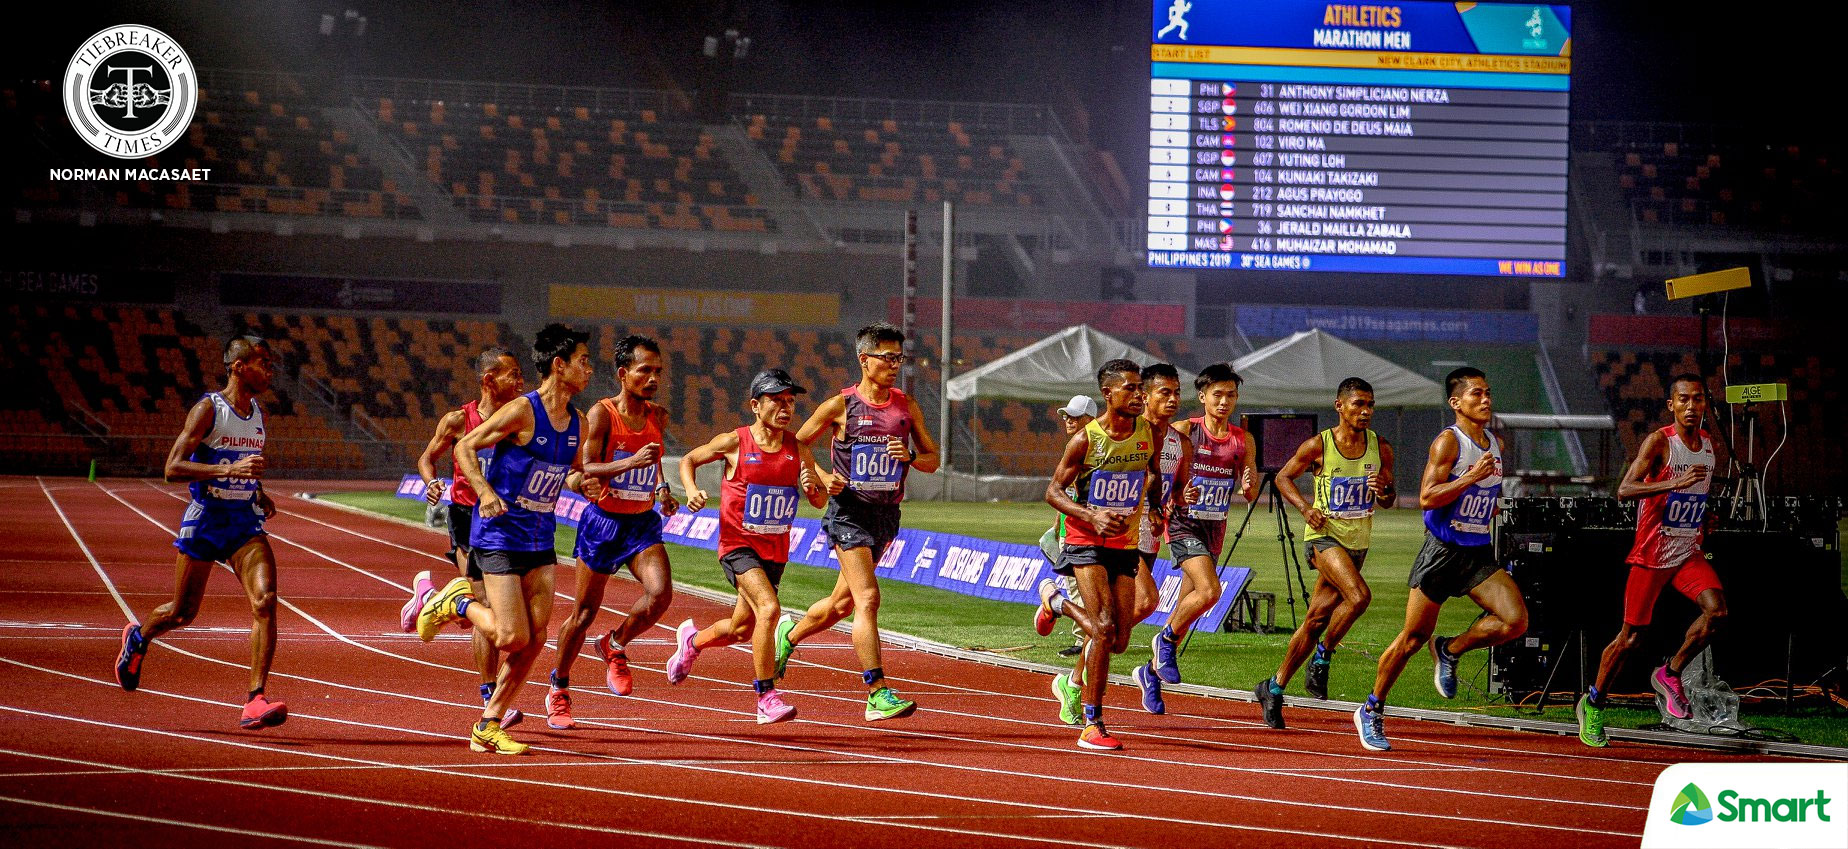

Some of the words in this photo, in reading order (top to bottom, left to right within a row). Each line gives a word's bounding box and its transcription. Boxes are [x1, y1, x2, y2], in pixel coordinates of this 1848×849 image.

[1323, 4, 1402, 28] ATHLETICS
[1313, 28, 1382, 49] MARATHON
[1383, 31, 1411, 50] MEN
[1152, 48, 1186, 59] START
[1188, 49, 1211, 60] LIST
[1378, 56, 1400, 65] NEW
[1403, 57, 1436, 66] CLARK
[1466, 58, 1520, 68] ATHLETICS
[1524, 59, 1567, 69] STADIUM
[1200, 83, 1220, 97] PHI
[1260, 84, 1275, 98] 31
[1279, 85, 1335, 100] ANTHONY
[1336, 87, 1410, 101] SIMPLICIANO
[1410, 89, 1450, 103] NERZA
[1254, 101, 1275, 115] 606
[1279, 102, 1301, 117] WEI
[1302, 103, 1339, 118] XIANG
[1339, 104, 1388, 119] GORDON
[1389, 105, 1411, 119] LIM
[1198, 117, 1220, 131] TLS
[1254, 117, 1275, 132] 804
[1279, 119, 1333, 134] ROMENIO
[1333, 120, 1350, 134] DE
[1351, 121, 1383, 135] DEUS
[1383, 122, 1413, 136] MAIA
[1196, 134, 1221, 148] CAM
[1254, 135, 1275, 149] 102
[1278, 136, 1306, 150] VIRO
[1306, 136, 1326, 151] MA
[1253, 152, 1274, 166] 607
[1278, 153, 1321, 168] YUTING
[1321, 154, 1346, 169] LOH
[1195, 168, 1220, 182] CAM
[1254, 169, 1274, 183] 104
[1277, 170, 1326, 185] KUNIAKI
[1326, 171, 1379, 186] TAKIZAKI
[1197, 186, 1217, 199] INA
[1252, 186, 1274, 200] 212
[1277, 187, 1309, 201] AGUS
[1310, 188, 1364, 203] PRAYOGO
[1196, 202, 1218, 216] THA
[1251, 203, 1273, 217] 719
[1276, 204, 1328, 219] SANCHAI
[1329, 205, 1386, 220] NAMKHET
[1197, 219, 1216, 233] PHI
[1257, 220, 1272, 234] 36
[1276, 221, 1321, 236] JERALD
[1322, 222, 1365, 237] MAILLA
[1366, 223, 1412, 239] ZABALA
[1194, 237, 1218, 251] MAS
[1251, 237, 1273, 251] 416
[1276, 238, 1336, 253] MUHAIZAR
[1337, 240, 1397, 255] MOHAMAD
[1148, 251, 1209, 267] PHILIPPINES
[1209, 252, 1233, 268] 2019
[1254, 254, 1271, 268] SEA
[1271, 254, 1301, 269] GAMES
[1498, 260, 1513, 275] WE
[1514, 260, 1532, 275] WIN
[1544, 261, 1560, 276] ONE
[49, 272, 99, 295] GAMES
[221, 436, 264, 449] PILIPINAS
[1193, 462, 1233, 476] SINGAPORE
[1093, 478, 1139, 502] 0804
[1333, 483, 1373, 506] 0416
[749, 493, 796, 519] 0104
[1459, 494, 1497, 519] 0031
[1668, 500, 1706, 523] 0212
